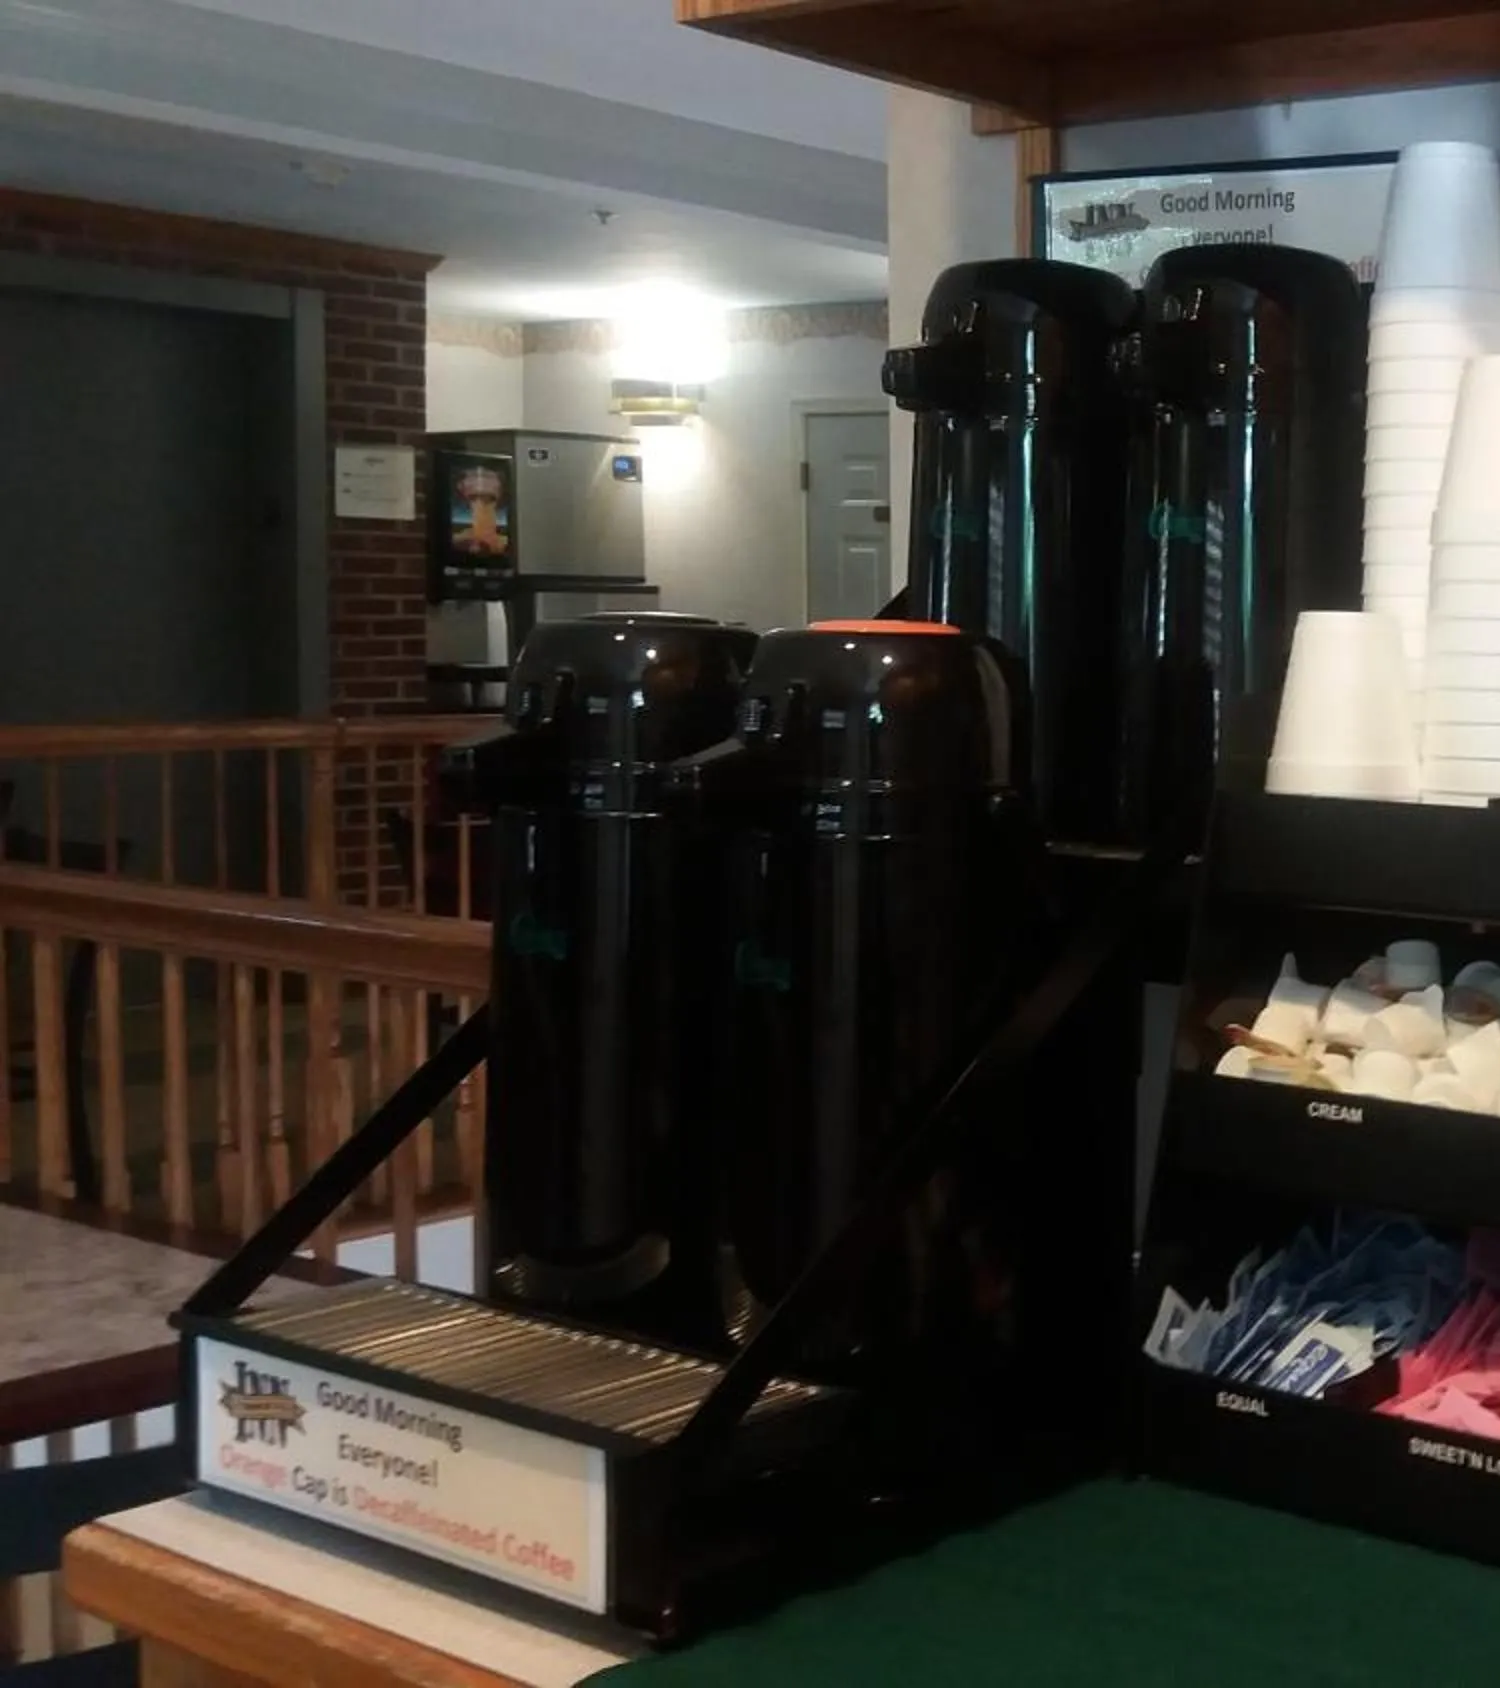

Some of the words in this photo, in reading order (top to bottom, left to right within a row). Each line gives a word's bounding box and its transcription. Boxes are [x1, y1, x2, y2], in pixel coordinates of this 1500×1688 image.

[1160, 191, 1209, 213] Good
[1214, 187, 1296, 213] Morning
[1307, 1101, 1363, 1124] CREAM
[316, 1380, 369, 1419] Good
[375, 1397, 463, 1453] Morning
[1216, 1390, 1269, 1417] EQUAL
[337, 1433, 439, 1488] Everyone!
[1409, 1437, 1484, 1471] SWEET'N
[220, 1443, 288, 1488] Orange
[292, 1465, 329, 1501] Cap
[332, 1476, 349, 1507] is
[353, 1485, 497, 1555] Decaffeinated
[502, 1533, 576, 1583] Coffee
